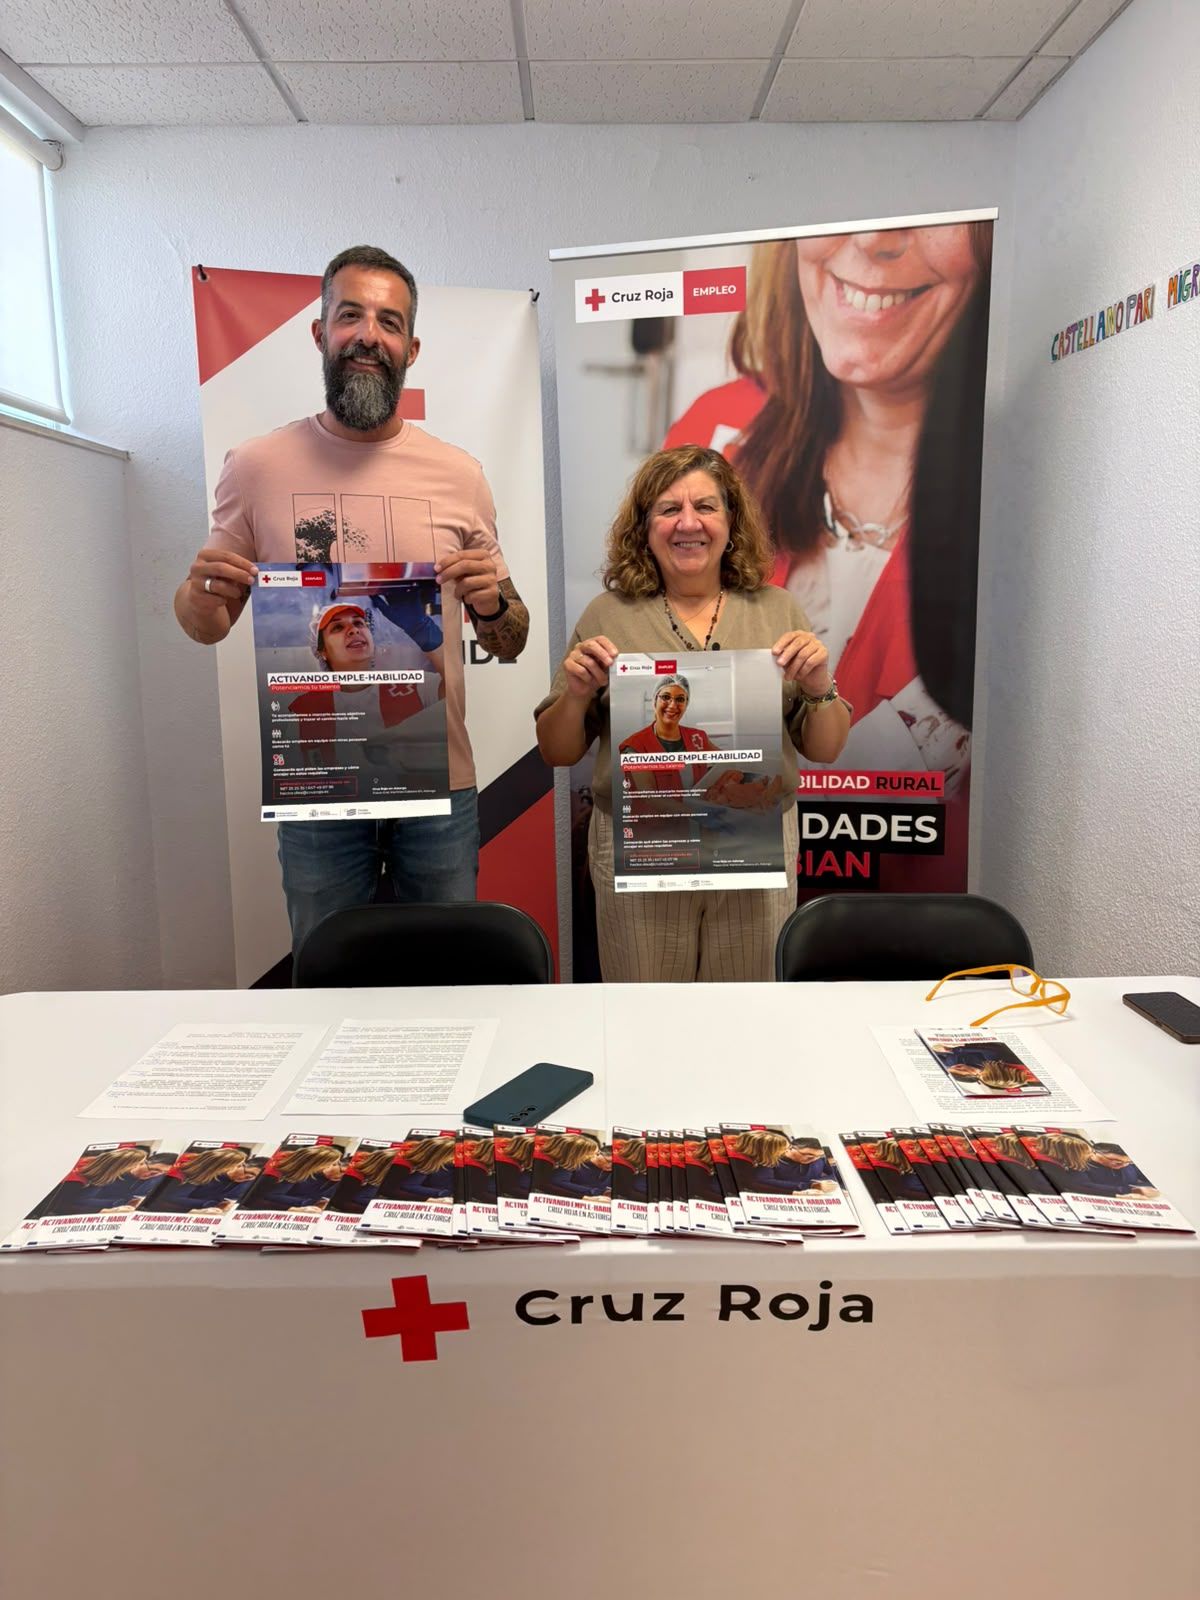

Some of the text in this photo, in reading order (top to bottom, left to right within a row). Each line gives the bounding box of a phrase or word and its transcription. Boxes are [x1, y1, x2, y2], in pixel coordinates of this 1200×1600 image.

[611, 285, 736, 303] Cruz Roja EMPLEO
[1051, 301, 1124, 361] CASTELLANO
[1168, 264, 1200, 308] MIGR
[270, 673, 423, 683] ACTIVANDO EMPLE-HABILIDAD
[622, 752, 761, 763] ACTIVANDO EMPLE-HABILIDAD
[875, 776, 941, 791] RURAL
[802, 812, 937, 843] DADES
[533, 1196, 571, 1207] ACTIVANDO
[746, 1195, 784, 1204] ACTIVANDO
[1072, 1195, 1109, 1205] ACTIVANDO
[373, 1202, 411, 1211] ACTIVANDO
[41, 1217, 81, 1226] ACTIVANDO
[131, 1214, 170, 1223] ACTIVANDO
[232, 1213, 271, 1221] ACTIVANDO
[515, 1279, 874, 1331] Cruz Roja
